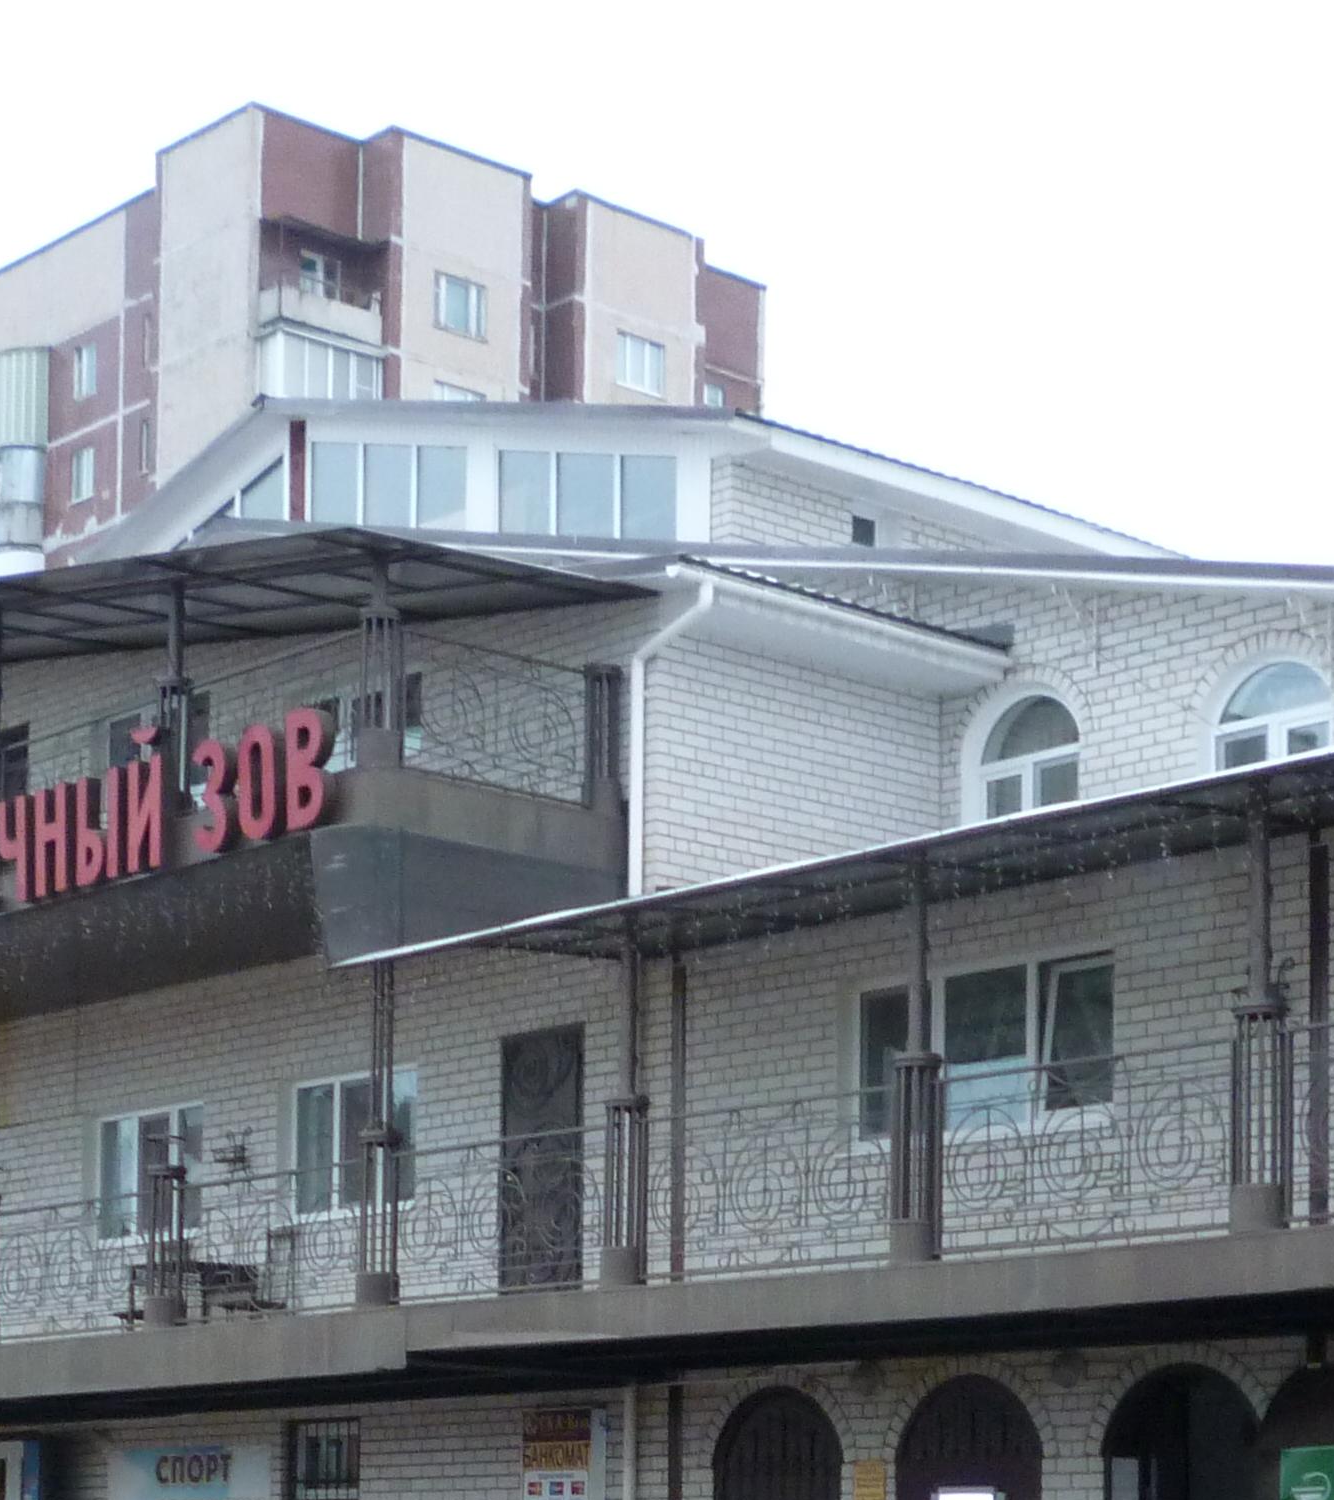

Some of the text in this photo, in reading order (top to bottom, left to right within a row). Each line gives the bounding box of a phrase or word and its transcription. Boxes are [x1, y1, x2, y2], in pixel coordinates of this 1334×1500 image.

[192, 707, 325, 854] ЗОВ
[155, 1454, 232, 1485] СПОРТ
[522, 1442, 591, 1469] БАНКОМАТ
